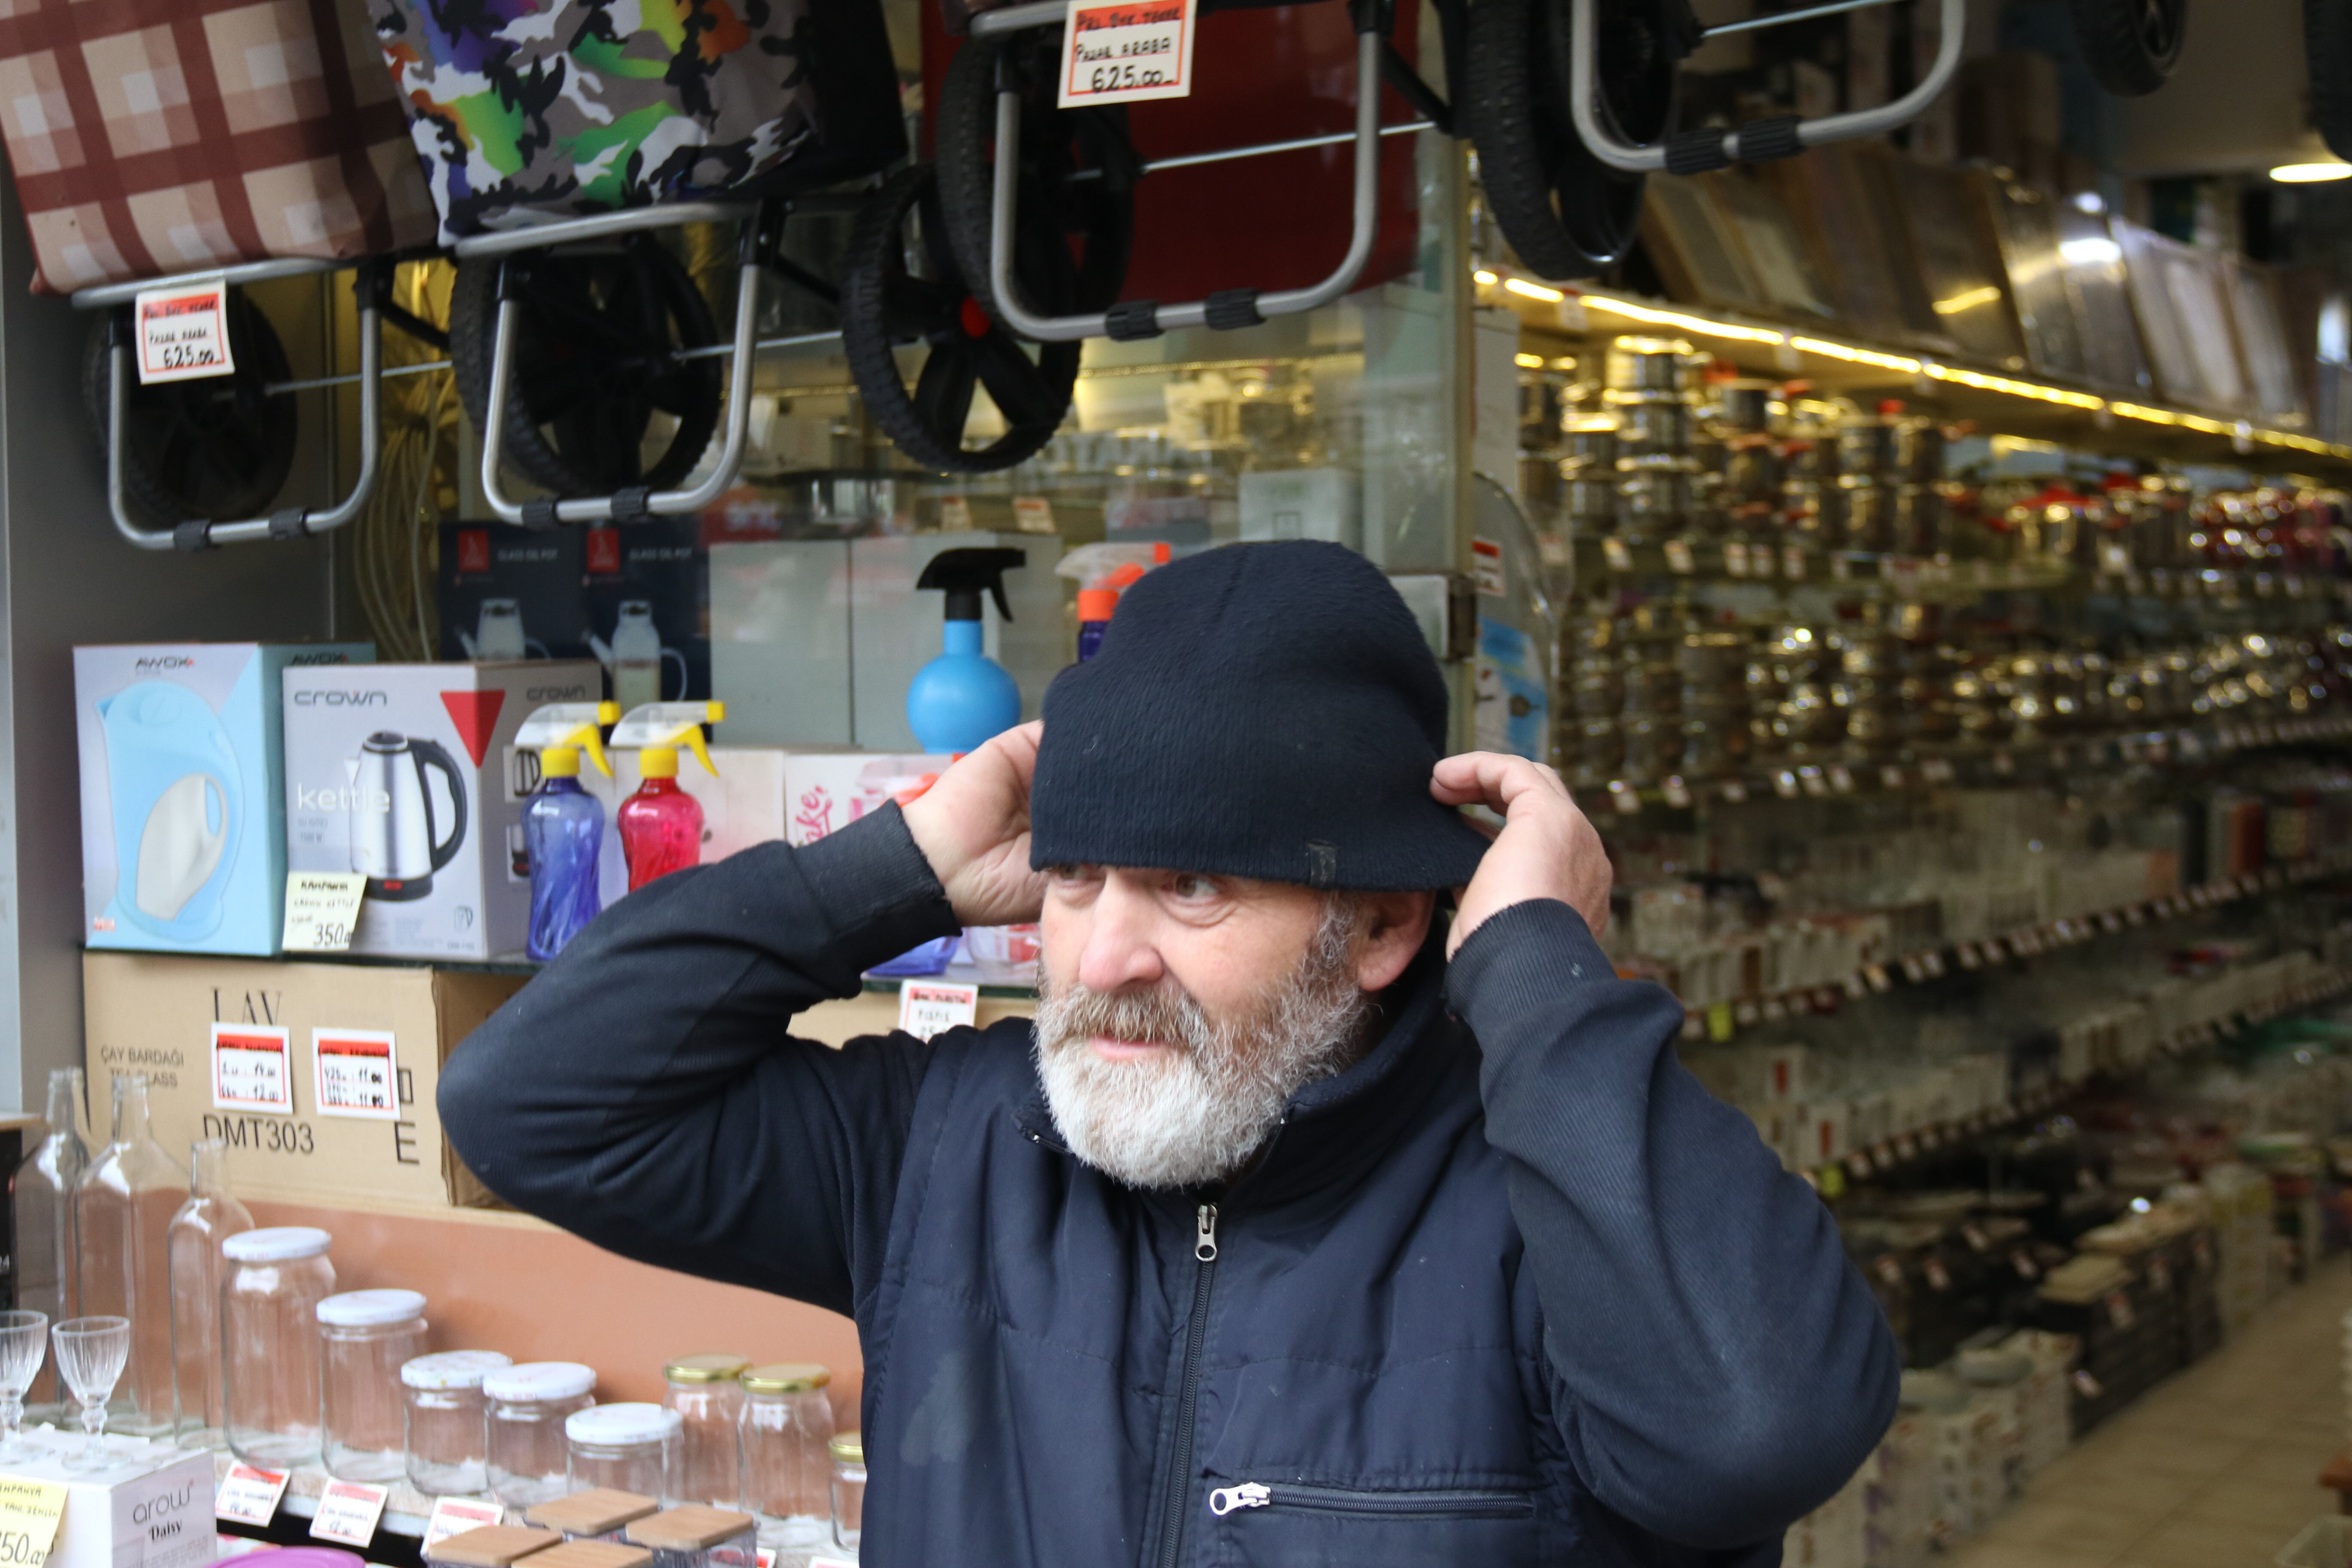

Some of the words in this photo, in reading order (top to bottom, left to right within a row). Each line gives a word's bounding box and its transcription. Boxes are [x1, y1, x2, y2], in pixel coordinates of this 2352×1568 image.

[135, 656, 190, 669] AWOX
[291, 652, 344, 665] AWOX
[294, 689, 387, 706] crown
[527, 686, 586, 701] crown
[297, 783, 391, 812] kettle
[101, 1044, 125, 1064] ÇAY
[129, 1046, 184, 1067] BARDAĞI
[202, 1114, 315, 1155] DMT303
[133, 1485, 190, 1525] arow
[149, 1519, 182, 1542] Daisy
